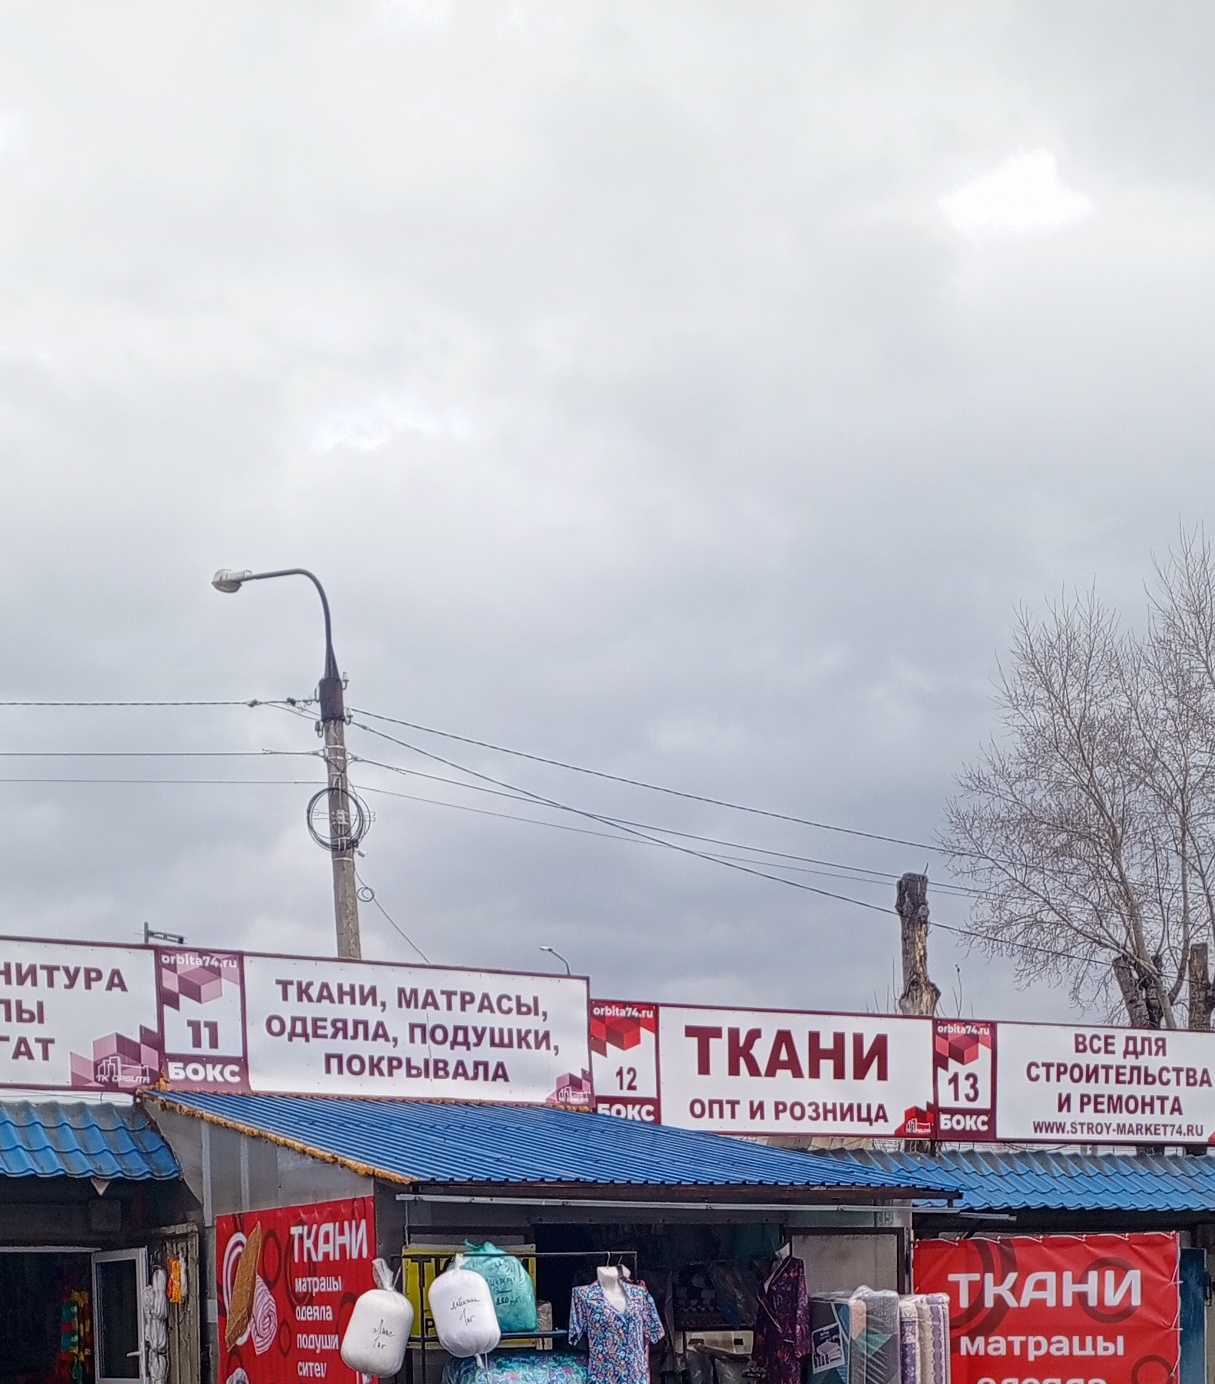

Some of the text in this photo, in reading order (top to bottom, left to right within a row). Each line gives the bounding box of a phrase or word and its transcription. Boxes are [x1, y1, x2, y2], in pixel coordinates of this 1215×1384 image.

[162, 953, 238, 969] orbita74.ru
[275, 979, 548, 1021] ТКАНИ, МАТРАСЫ,
[593, 1006, 655, 1019] orbita74.ru
[186, 1019, 219, 1050] 11
[265, 1014, 560, 1056] ОДЕЯЛА, ПОДУШКИ,
[937, 1023, 990, 1036] orbita74.ru
[684, 1024, 889, 1082] ТКАНИ
[1074, 1033, 1167, 1060] ВСЕ ДЛЯ
[167, 1061, 242, 1084] БОКС
[324, 1053, 511, 1083] ПОКРЫВАЛА
[616, 1066, 638, 1091] 12
[1026, 1062, 1213, 1088] СТРОИТЕЛЬСТВА
[948, 1071, 980, 1103] 13
[597, 1103, 656, 1122] БОКС
[689, 1098, 741, 1120] ОПТ
[749, 1100, 765, 1121] И
[774, 1101, 890, 1126] РОЗНИЦА
[1057, 1093, 1184, 1116] И РЕМОНТА
[940, 1113, 990, 1132] БОКС
[1032, 1121, 1205, 1138] WWW.STROY-MARKET74.RU
[290, 1218, 370, 1264] ТКАНИ
[295, 1275, 342, 1296] матрацы
[947, 1269, 1142, 1309] ТКАНИ
[960, 1334, 1125, 1361] матрацы
